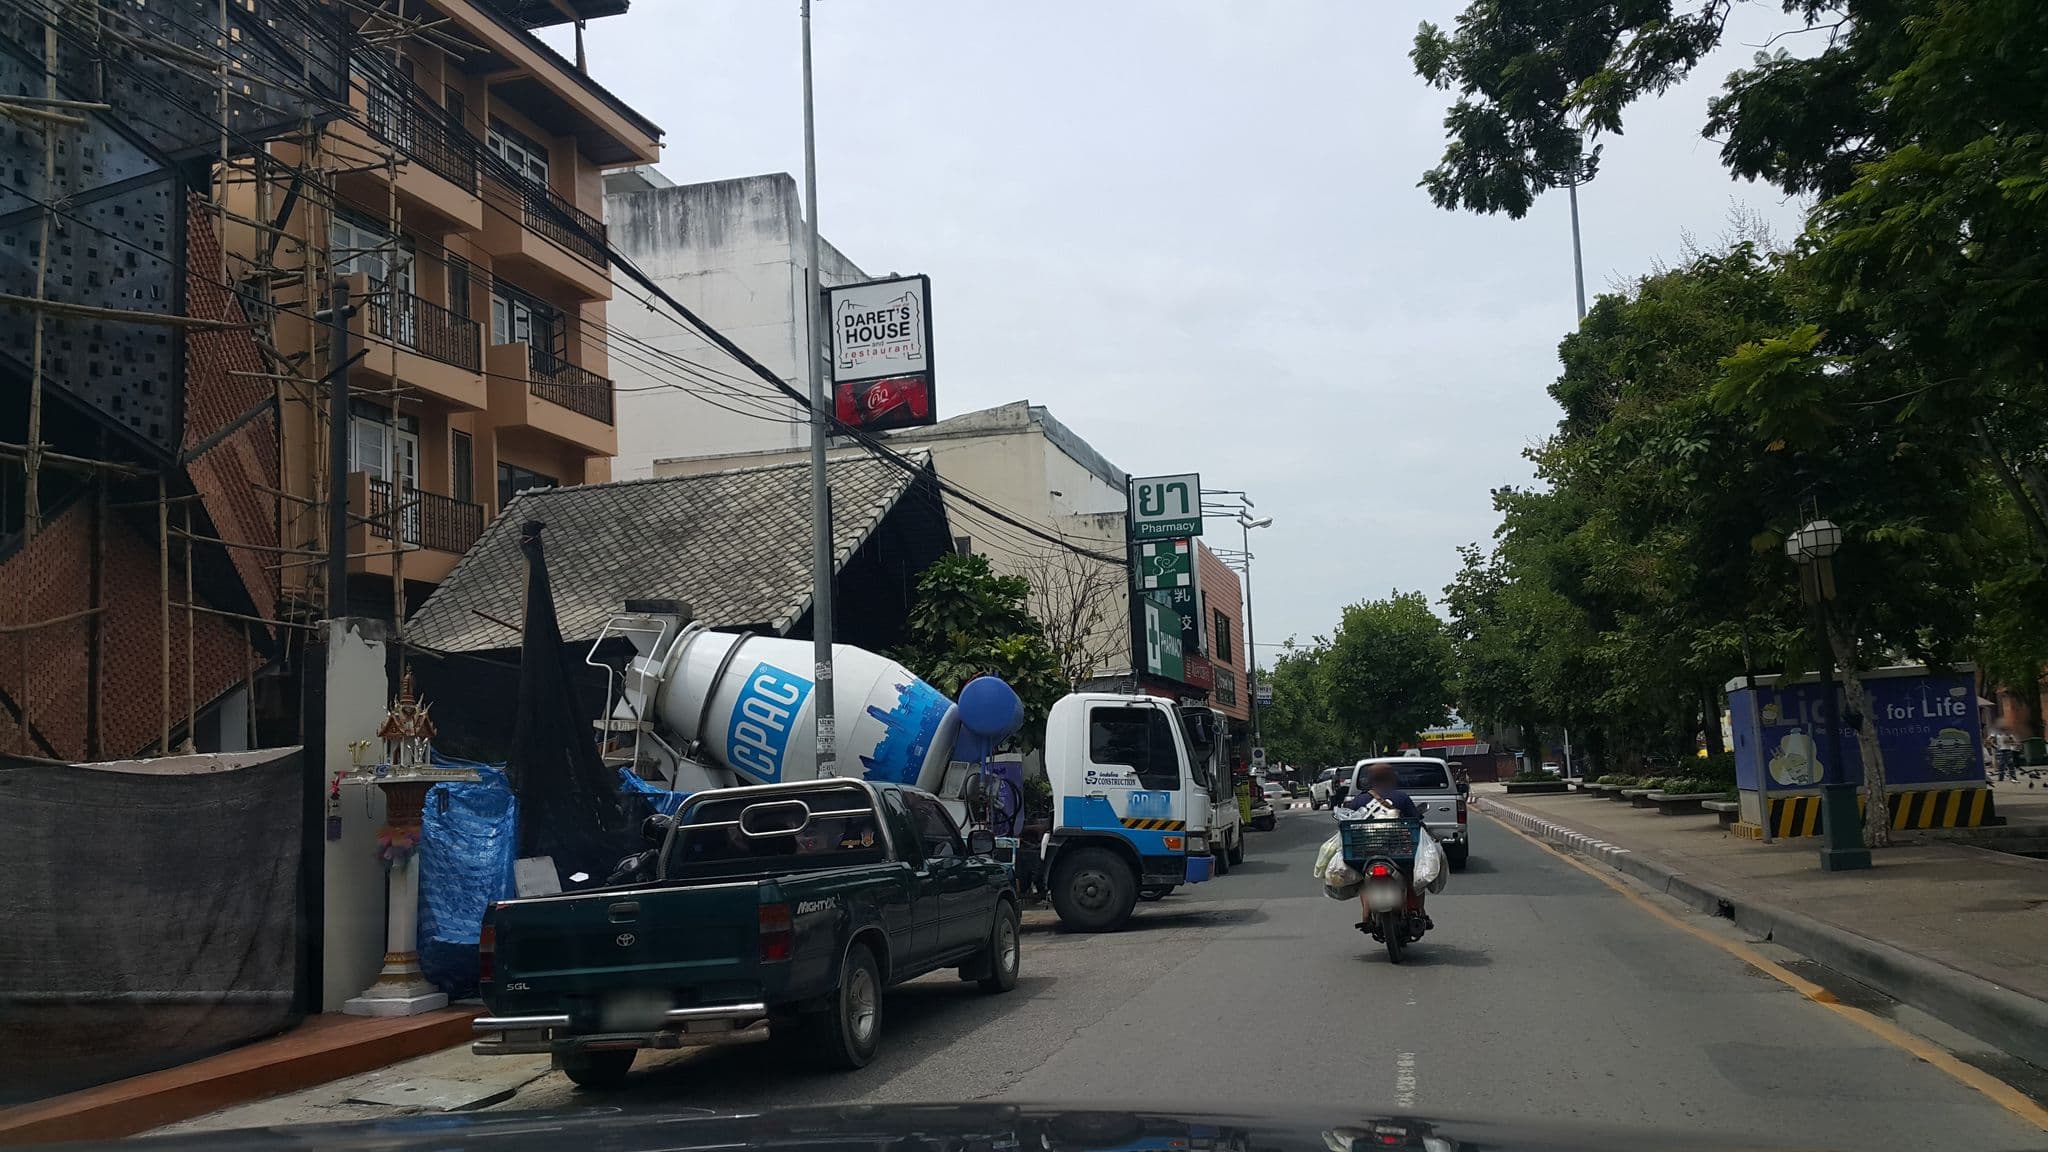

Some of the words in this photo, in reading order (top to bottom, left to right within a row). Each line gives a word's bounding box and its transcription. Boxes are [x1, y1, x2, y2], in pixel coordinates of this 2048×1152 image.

[844, 306, 910, 328] DARET'S
[846, 321, 911, 344] HOUSE
[844, 342, 915, 360] restaurant
[1138, 482, 1190, 516] ยา
[1141, 521, 1196, 534] Pharmacy
[1774, 687, 1879, 727] Lit
[1886, 703, 1915, 720] for
[1922, 696, 1967, 718] Life
[732, 674, 801, 776] CPAC
[1098, 777, 1136, 786] CONSTRUCTION
[506, 982, 531, 991] SGL
